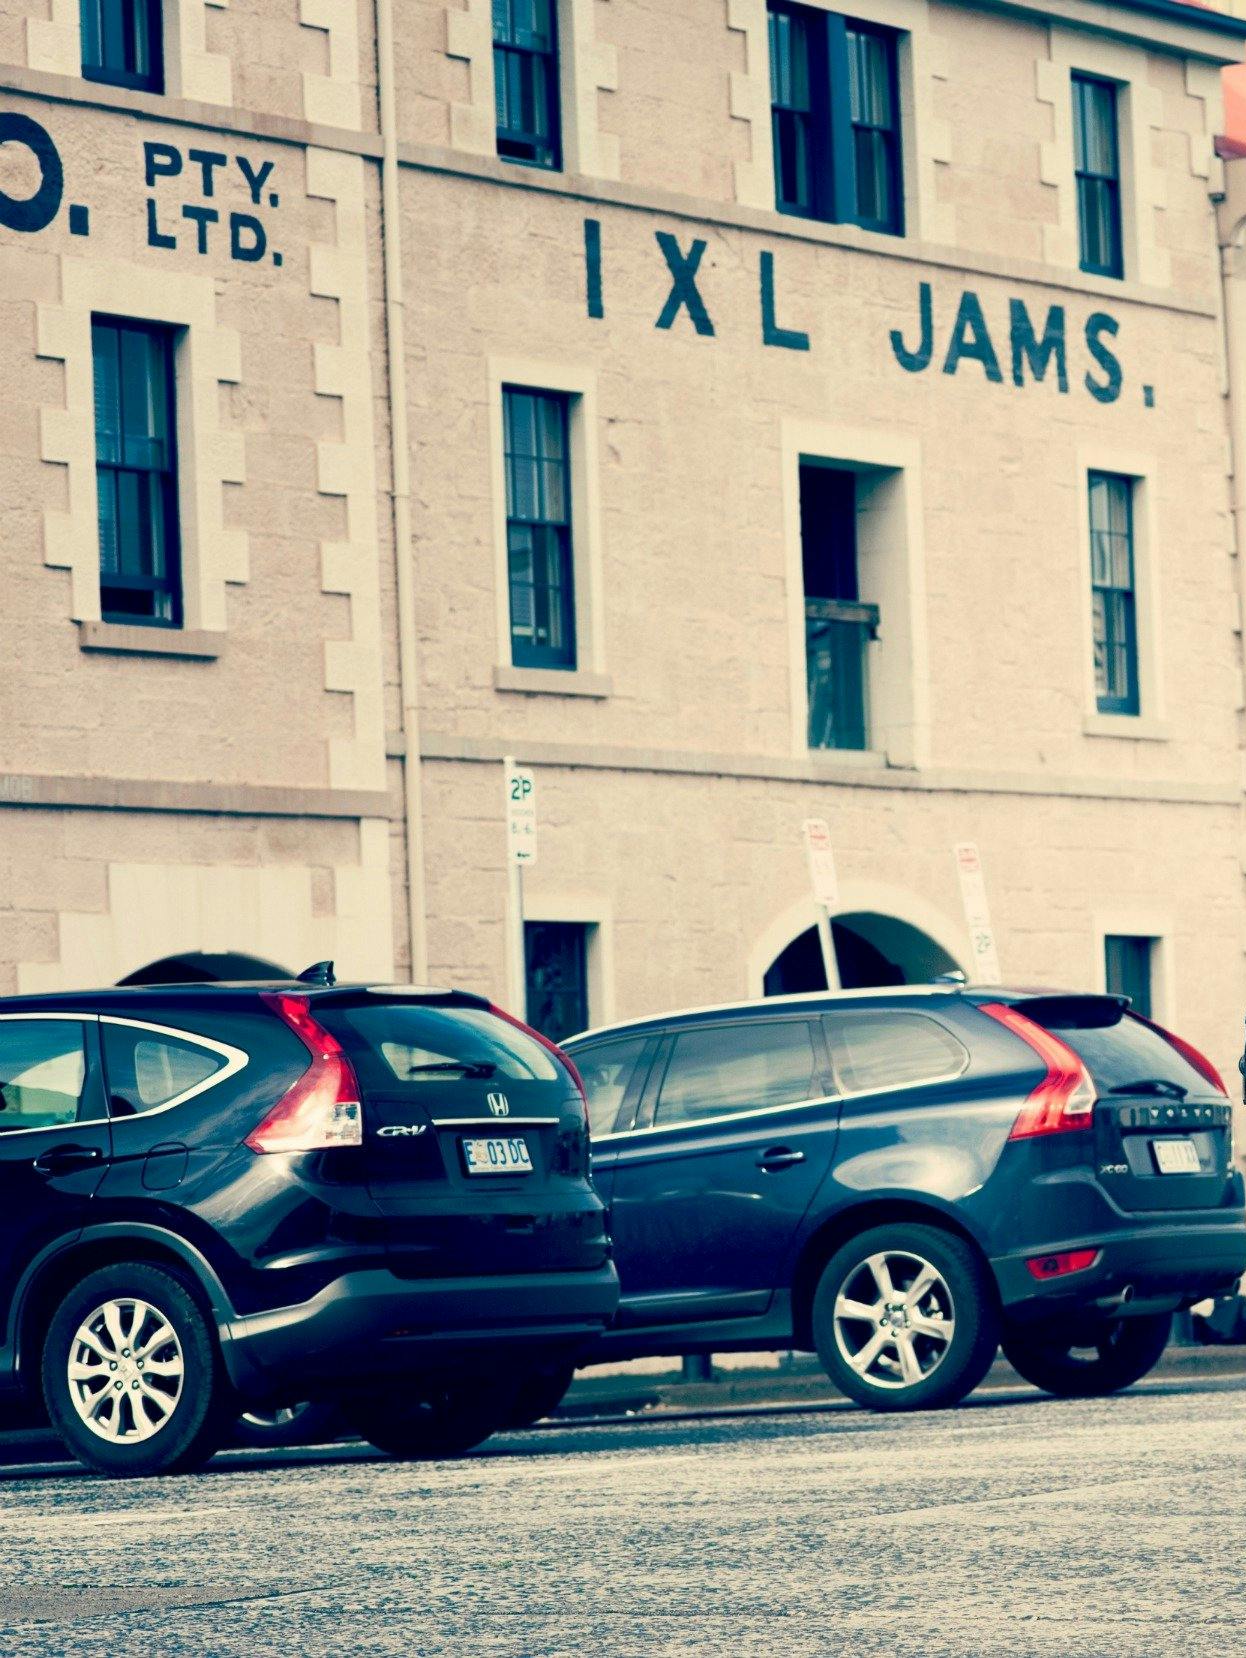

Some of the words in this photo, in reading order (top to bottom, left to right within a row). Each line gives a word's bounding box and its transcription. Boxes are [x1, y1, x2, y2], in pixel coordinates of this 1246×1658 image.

[143, 141, 279, 208] PTY.
[147, 198, 283, 267] LTD.
[890, 282, 1155, 408] JAMS.
[511, 779, 532, 800] 2P
